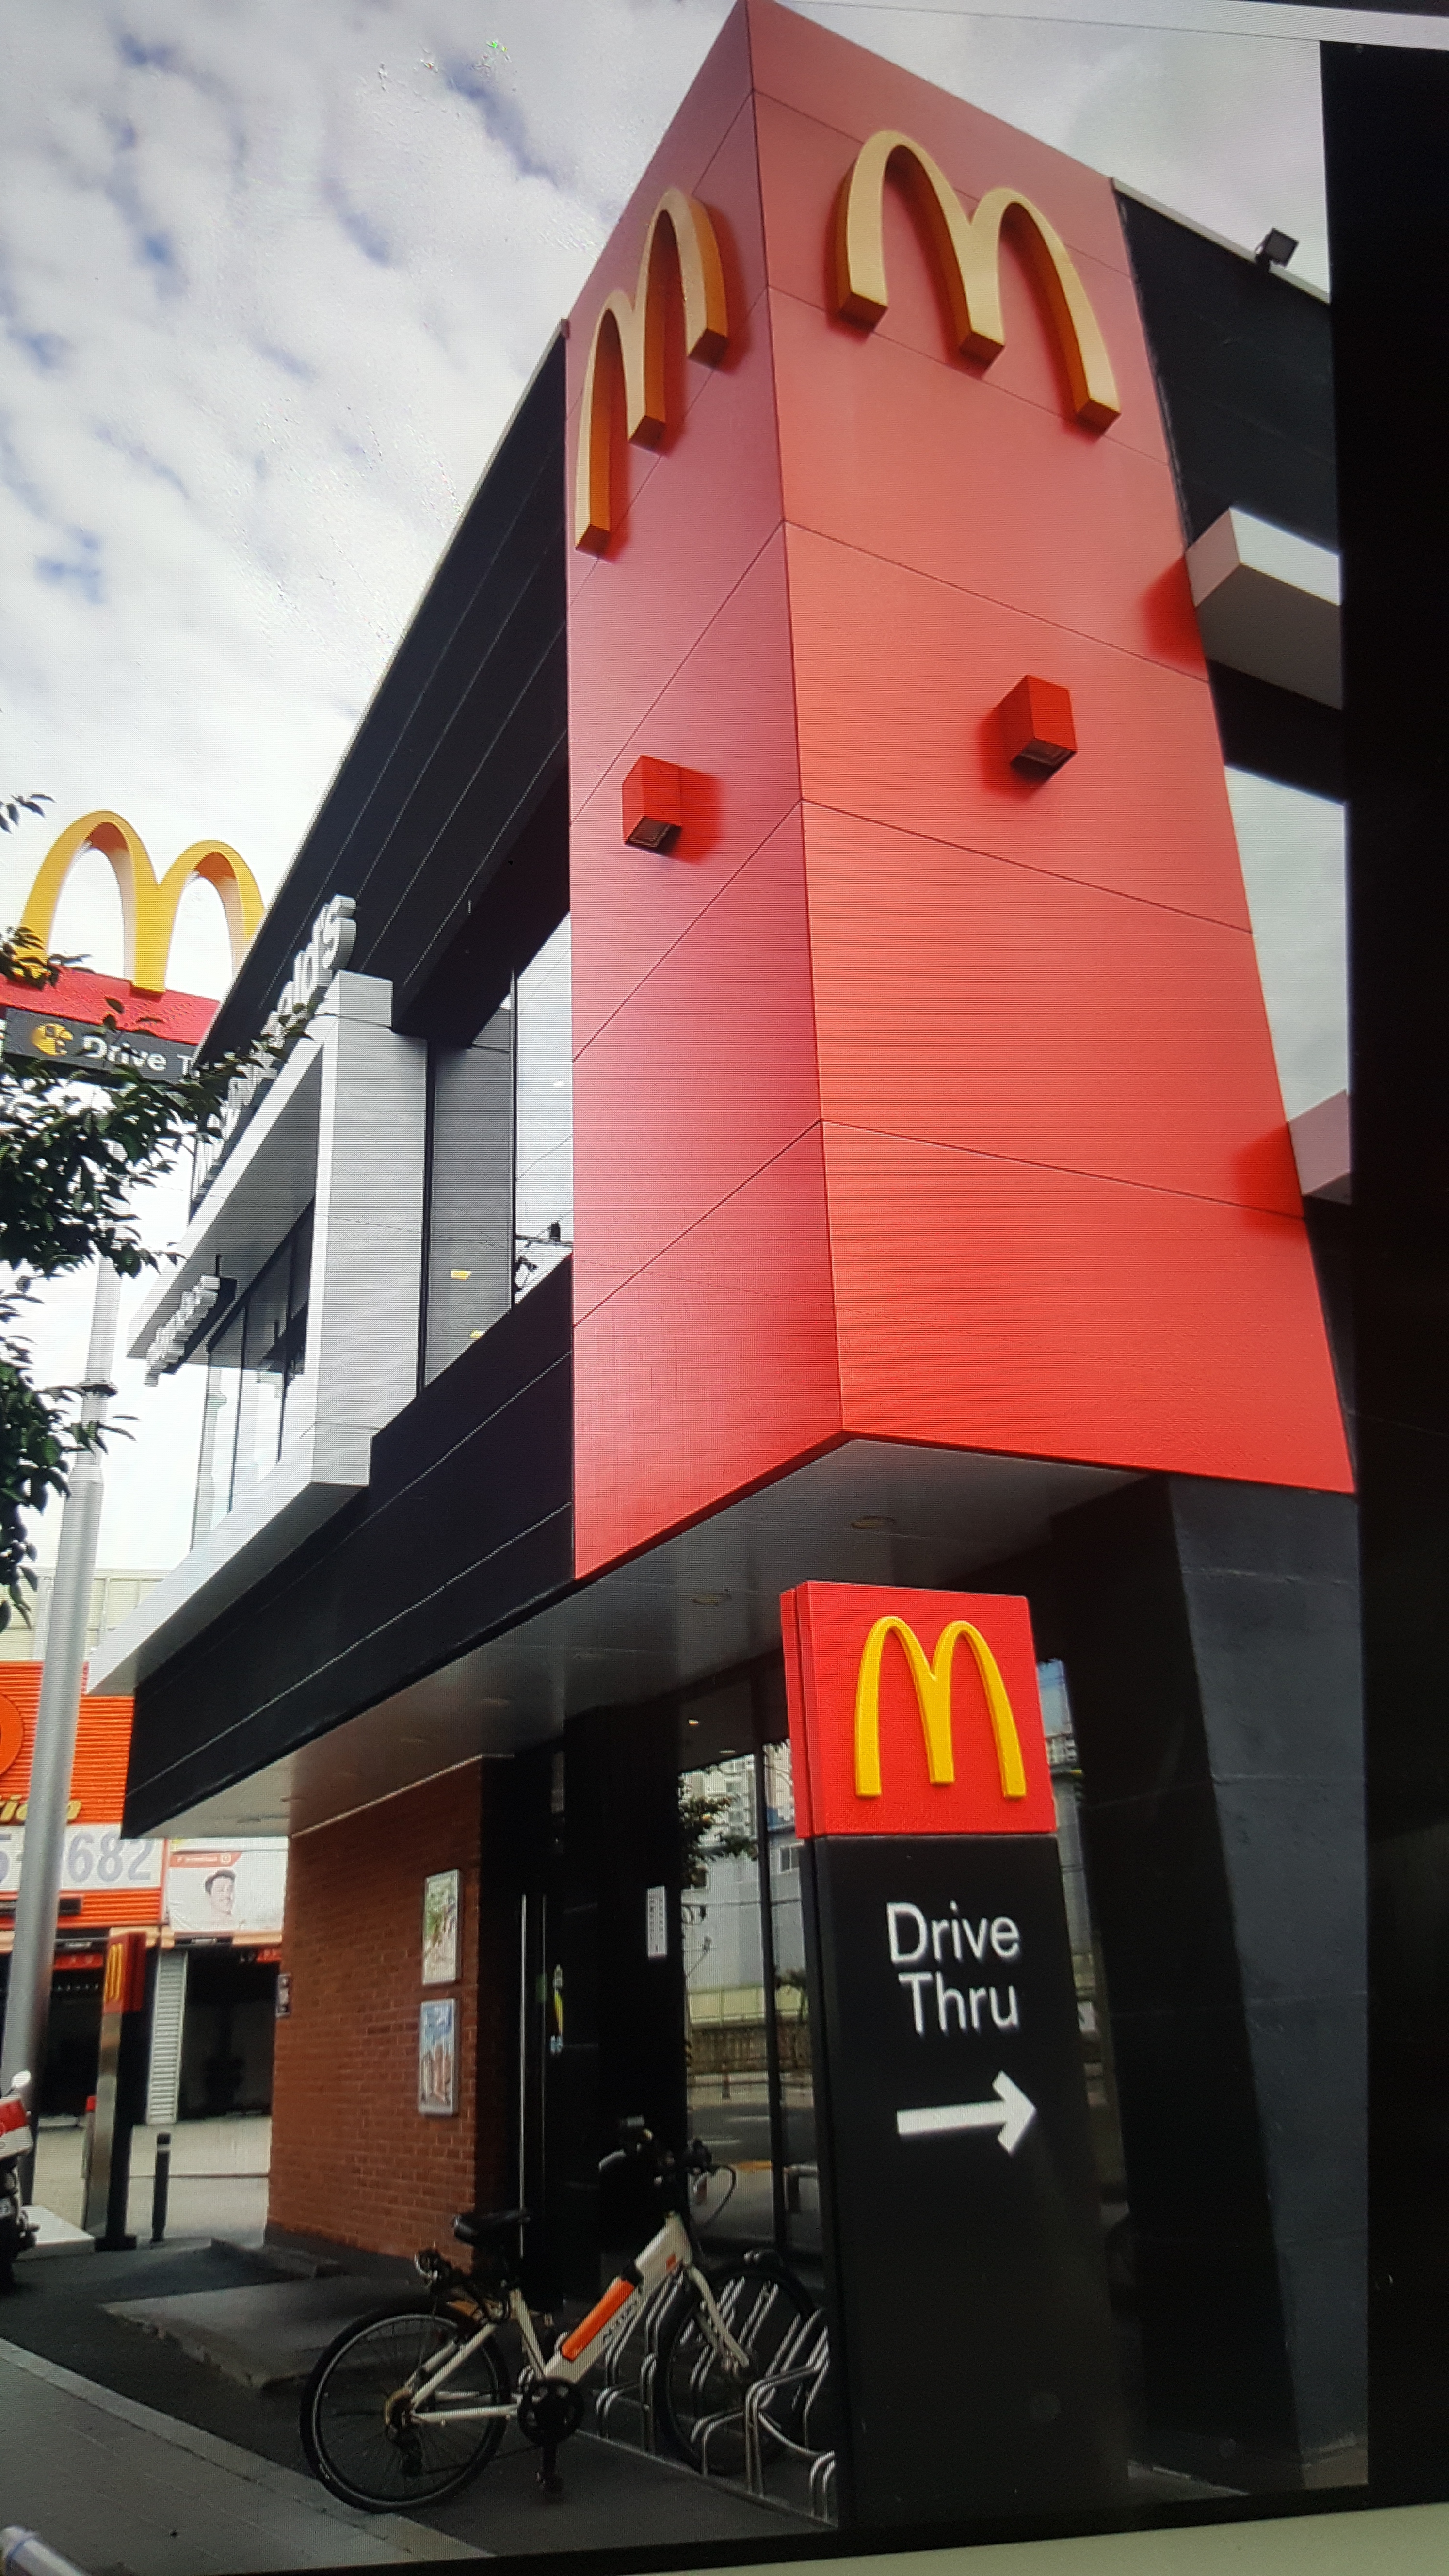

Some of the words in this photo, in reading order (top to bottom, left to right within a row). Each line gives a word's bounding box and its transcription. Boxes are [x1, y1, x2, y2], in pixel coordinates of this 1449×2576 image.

[83, 1034, 167, 1071] Drive
[886, 1900, 1021, 1966] Drive
[898, 1970, 1020, 2036] Thru
